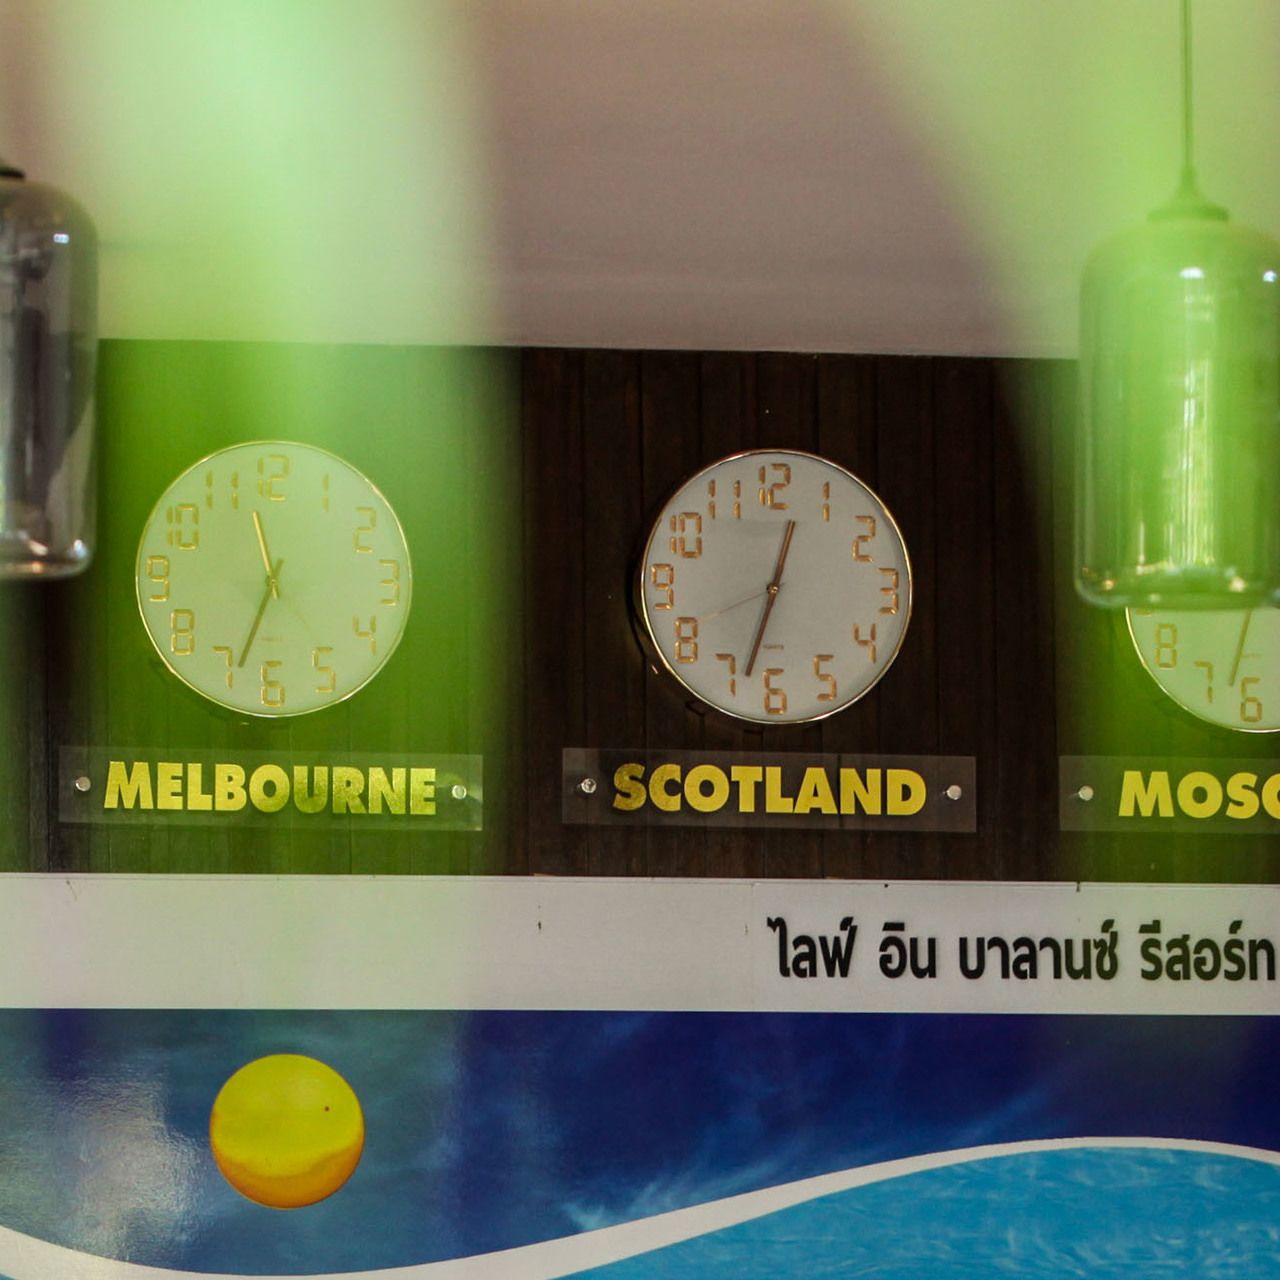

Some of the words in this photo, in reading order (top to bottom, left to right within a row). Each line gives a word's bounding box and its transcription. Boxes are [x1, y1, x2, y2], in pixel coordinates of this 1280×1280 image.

[206, 470, 239, 511] 11
[257, 454, 289, 501] 12
[708, 478, 741, 521] 11
[758, 462, 792, 510] 12
[823, 480, 830, 523] 1
[167, 503, 199, 550] 10
[353, 506, 376, 553] 2
[671, 511, 702, 559] 10
[852, 515, 876, 562] 2
[147, 555, 170, 602] 9
[379, 559, 401, 607] 3
[651, 563, 674, 610] 9
[878, 567, 899, 615] 3
[170, 608, 195, 656] 8
[352, 614, 376, 656] 4
[675, 617, 698, 664] 8
[853, 623, 877, 664] 4
[1154, 623, 1178, 670] 8
[213, 645, 233, 689] 7
[261, 660, 285, 707] 6
[312, 646, 336, 693] 5
[715, 653, 736, 697] 7
[814, 654, 837, 701] 5
[1193, 660, 1214, 703] 7
[763, 668, 787, 715] 6
[1240, 676, 1264, 723] 6
[104, 760, 437, 816] MELBOURNE
[612, 762, 928, 818] SCOTLAND
[767, 916, 858, 979] ไลฟ์
[878, 922, 936, 979] อิน
[959, 919, 1118, 981] บาลานซ์
[1138, 919, 1276, 982] รีสอร์ท
